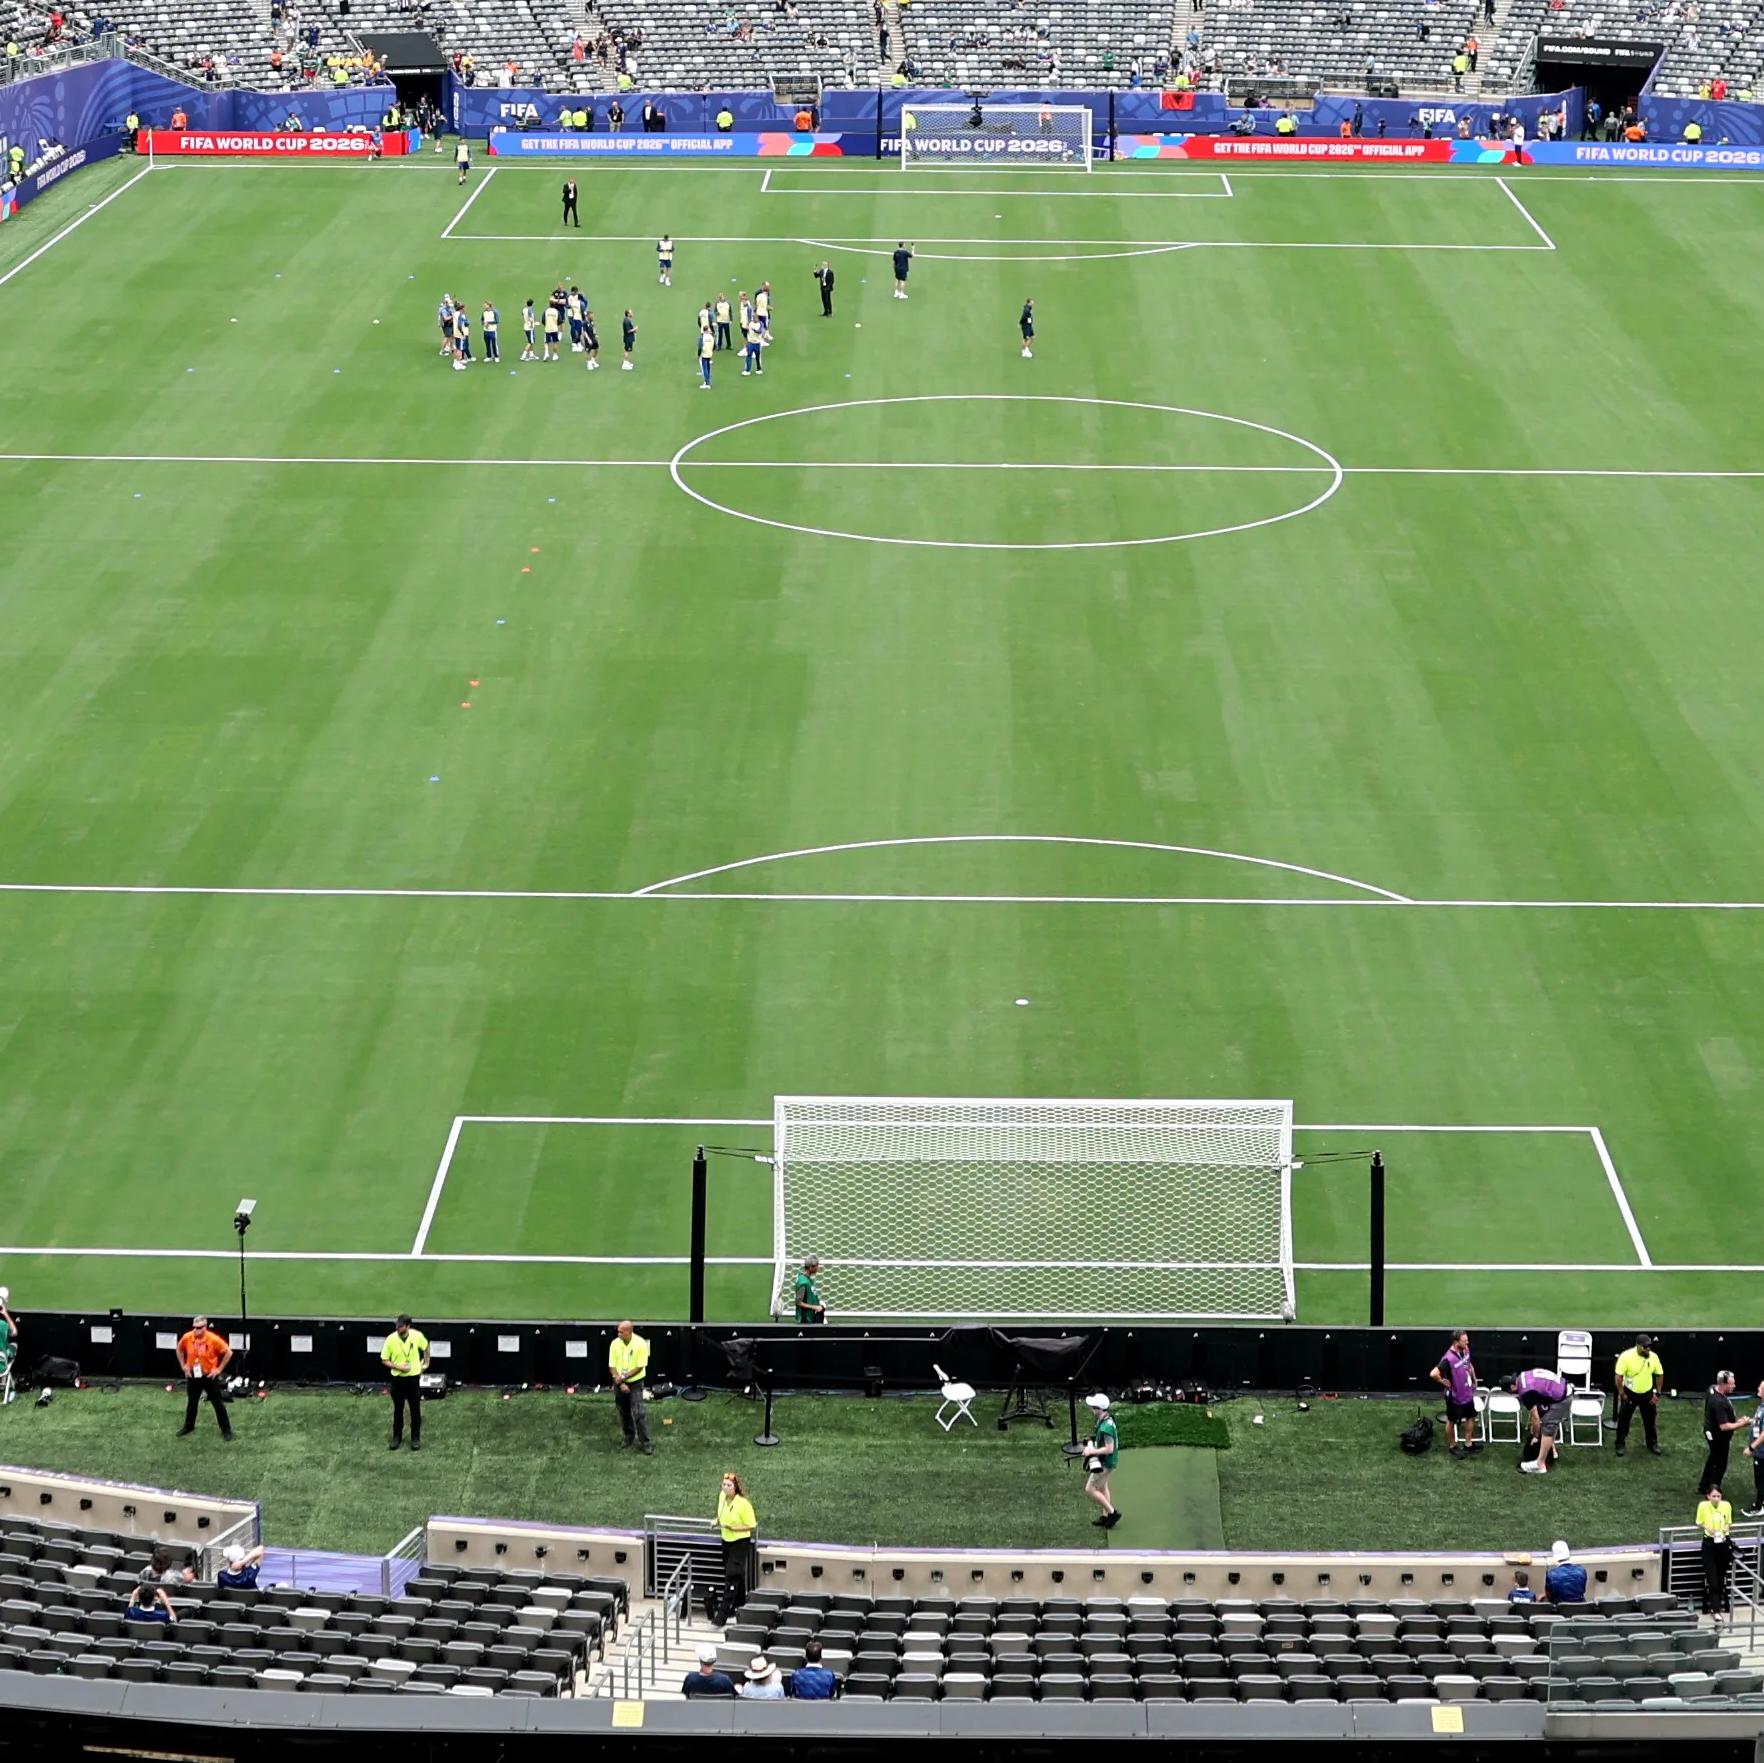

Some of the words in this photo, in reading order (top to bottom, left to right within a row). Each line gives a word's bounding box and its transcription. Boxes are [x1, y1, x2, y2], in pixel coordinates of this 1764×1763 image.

[500, 104, 538, 118] FIFA
[1419, 109, 1456, 123] FIFA
[180, 137, 214, 150] FIFA
[215, 137, 273, 150] WORLD
[275, 138, 308, 150] CUP
[1214, 143, 1232, 154] GET
[1233, 143, 1250, 154] THE
[1250, 143, 1272, 155] FIFA
[1272, 144, 1307, 155] WORLD
[1308, 144, 1327, 155] CUP
[1362, 144, 1404, 156] OFFICIAL
[1405, 145, 1425, 156] APP
[1576, 148, 1609, 161] FIFA
[1612, 149, 1668, 162] WORLD
[1671, 150, 1703, 163] CUP
